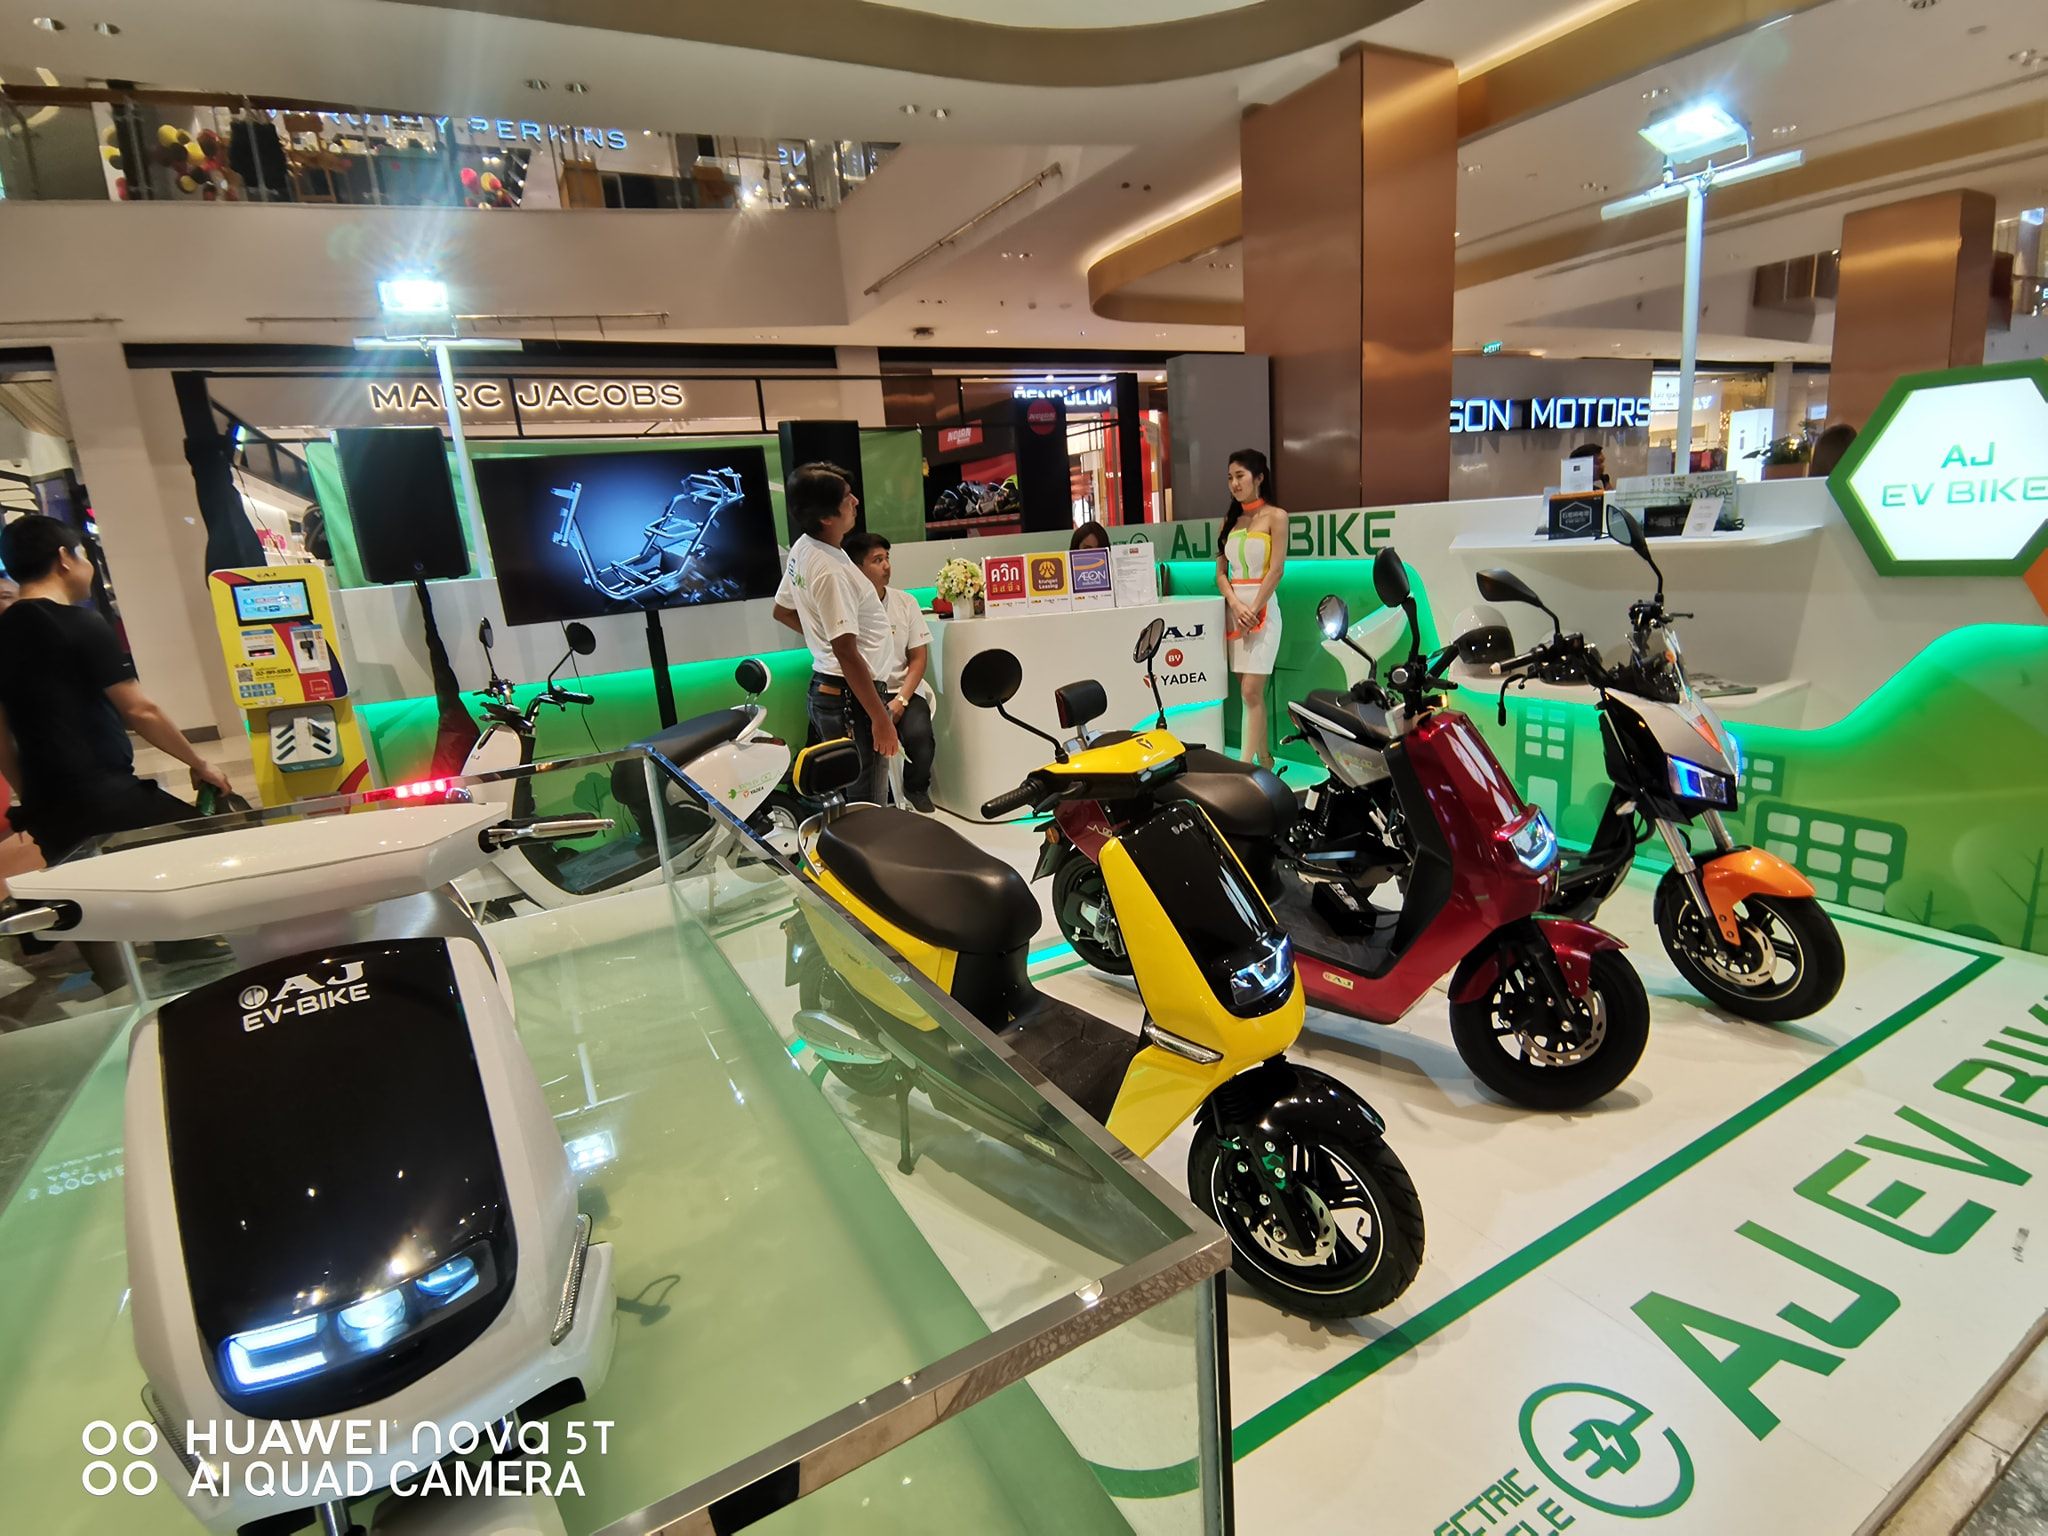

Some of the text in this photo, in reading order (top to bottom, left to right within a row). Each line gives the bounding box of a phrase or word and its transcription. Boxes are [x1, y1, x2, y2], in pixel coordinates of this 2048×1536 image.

[369, 383, 684, 409] MARC JACOBS
[1530, 397, 1651, 430] MOTORS
[1940, 441, 1996, 469] AJ
[1881, 475, 2048, 507] EV BIKE
[1170, 522, 1211, 560] AJ
[1162, 624, 1205, 639] AJ
[1168, 654, 1181, 662] BY
[1160, 671, 1207, 686] YADEA
[271, 960, 365, 1003] AJ
[242, 982, 371, 1033] EV-BIKE
[1630, 1219, 1901, 1441] AJ
[1792, 1104, 2034, 1255] EV
